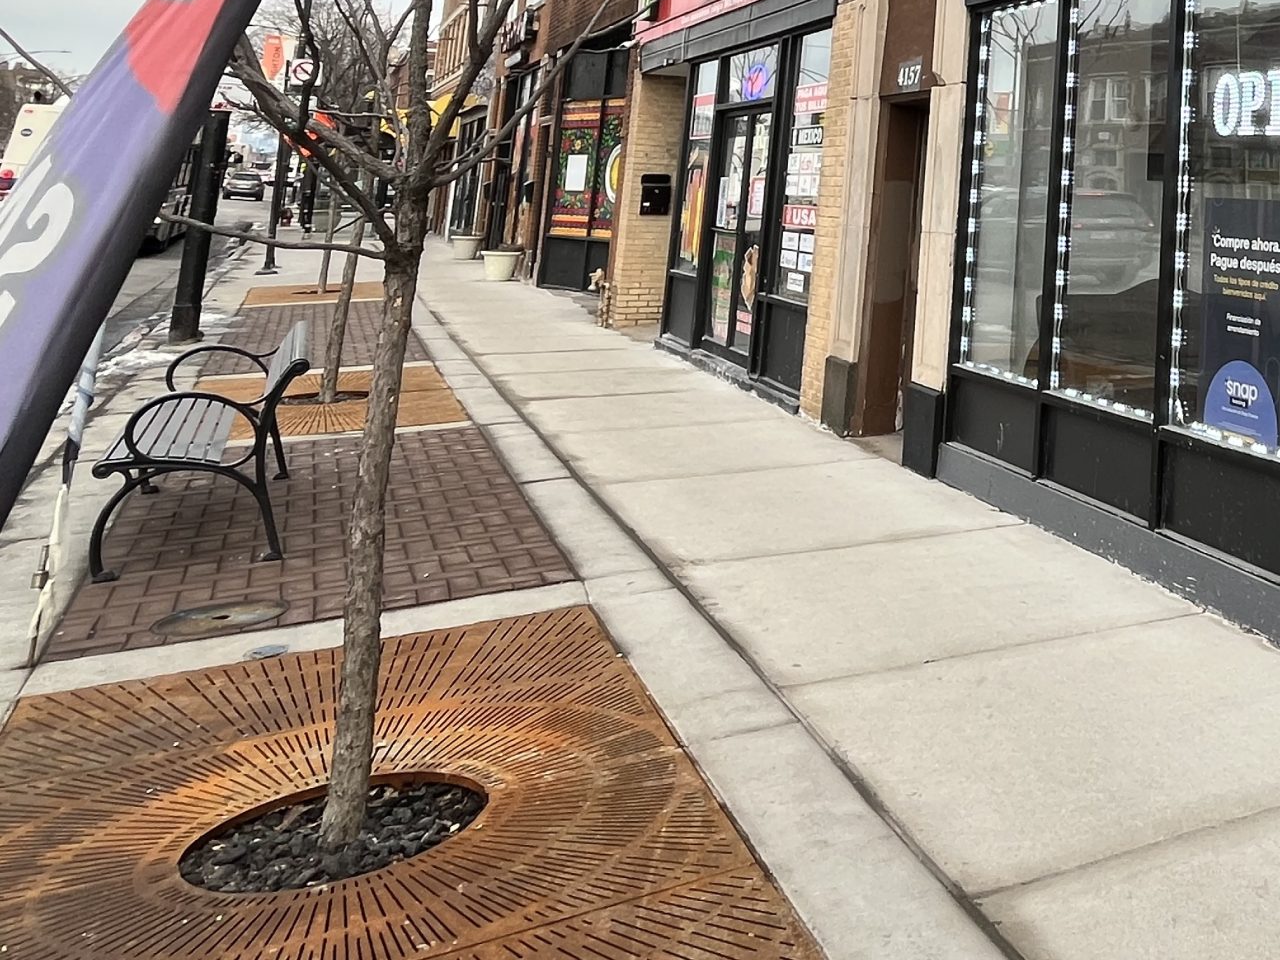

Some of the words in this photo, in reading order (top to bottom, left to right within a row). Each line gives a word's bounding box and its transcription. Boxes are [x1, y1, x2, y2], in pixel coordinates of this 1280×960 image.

[897, 64, 922, 86] 4157
[792, 210, 816, 227] USA
[1212, 233, 1250, 252] Compre
[1210, 252, 1238, 271] Pague
[1225, 379, 1258, 406] snap
